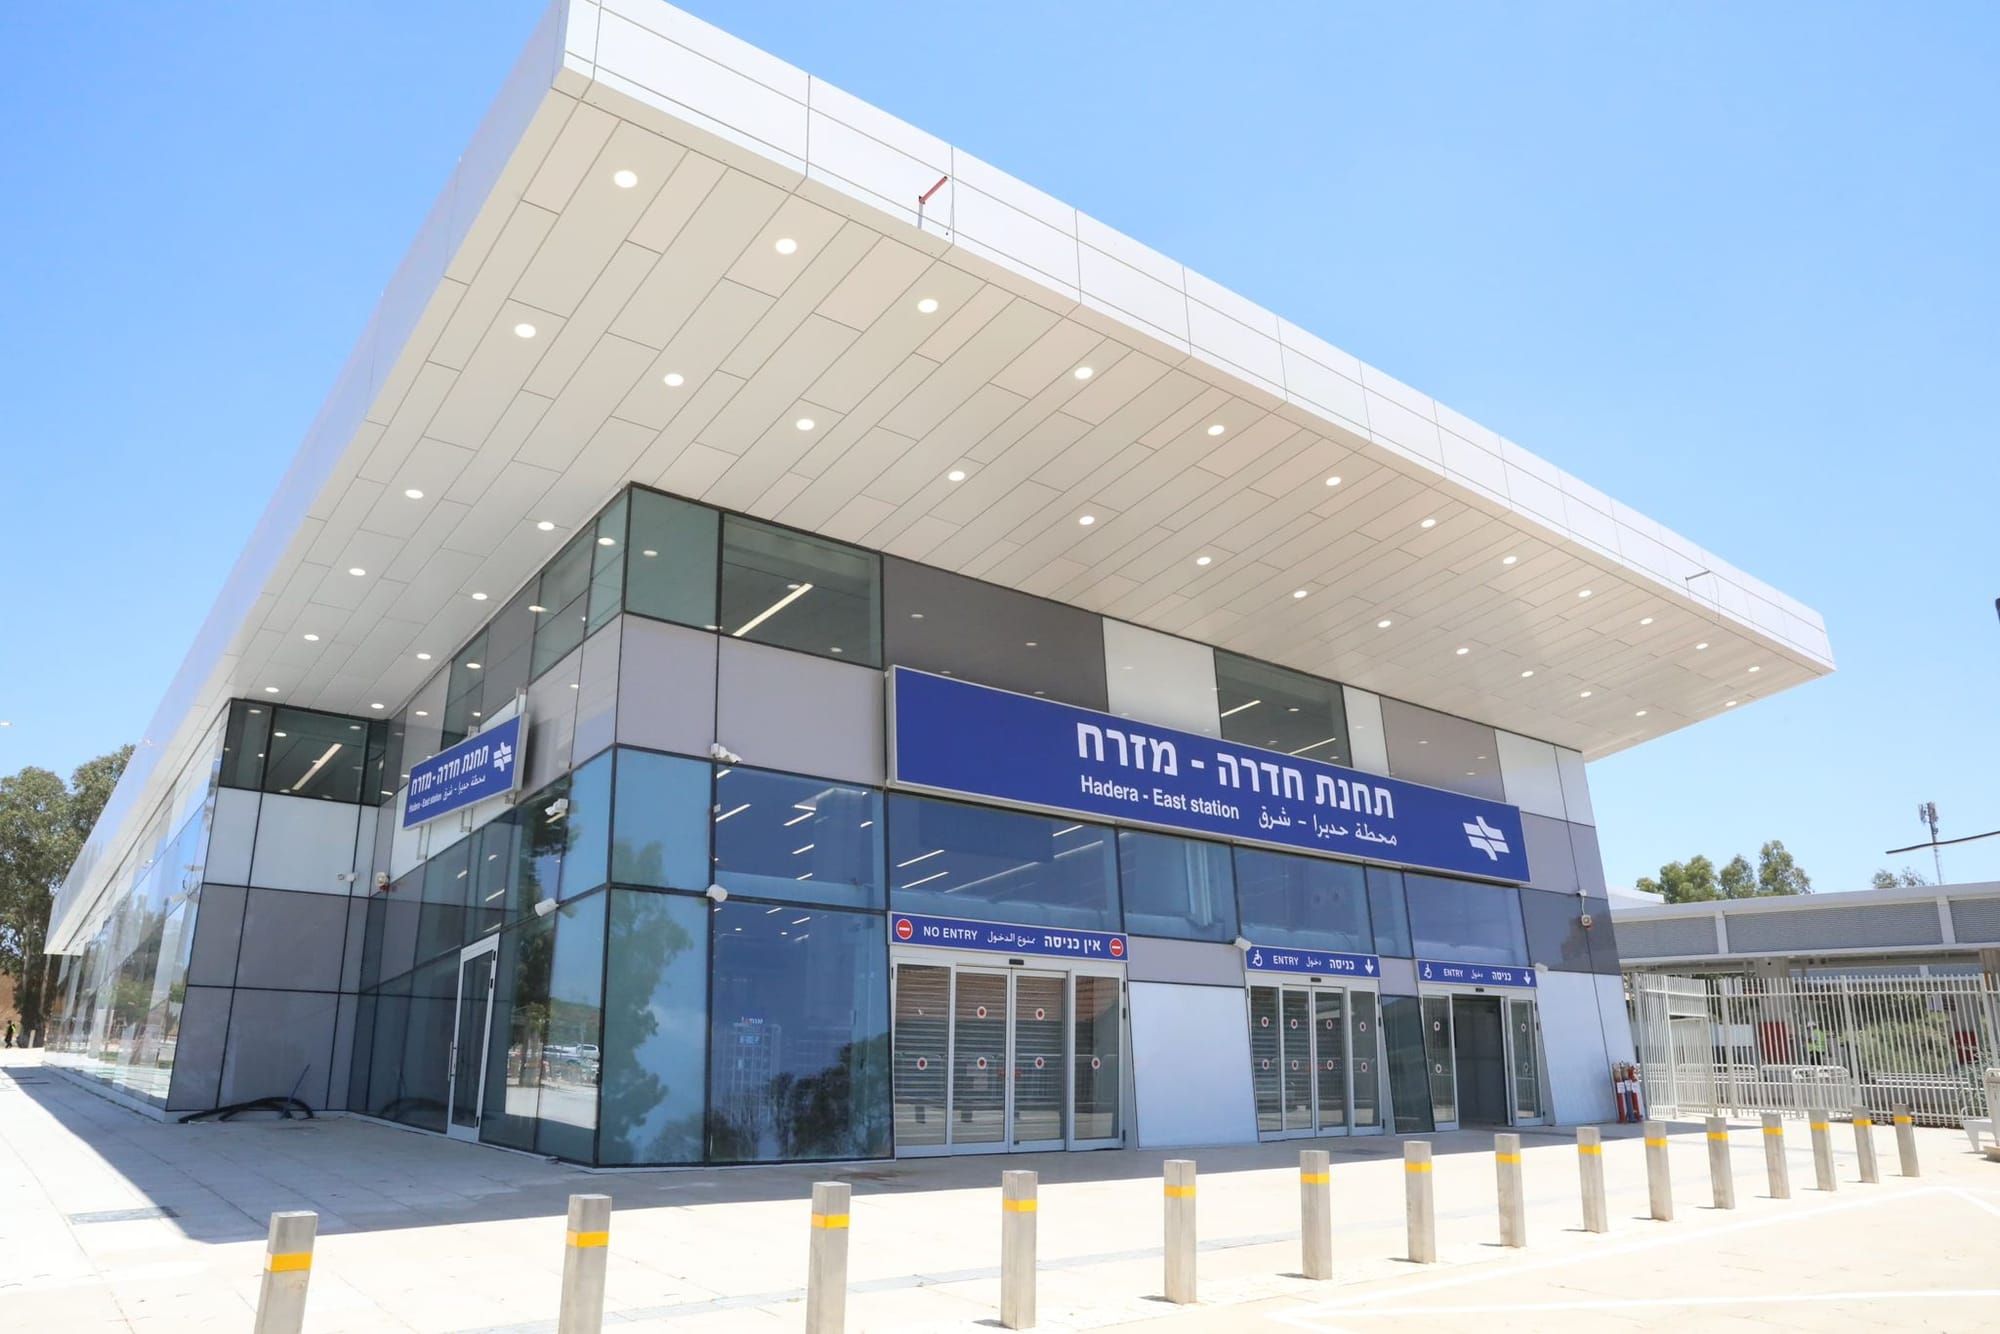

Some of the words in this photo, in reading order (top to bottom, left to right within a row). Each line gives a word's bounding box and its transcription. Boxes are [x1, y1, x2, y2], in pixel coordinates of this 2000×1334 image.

[1077, 722, 1178, 776] מזרח
[461, 745, 489, 775] תחנת
[1217, 752, 1305, 801] חדרה
[1081, 774, 1139, 802] Hadera
[1153, 788, 1187, 811] East
[1190, 797, 1240, 820] station
[1315, 774, 1394, 819] תחנת
[1258, 805, 1292, 830] شرق
[1313, 813, 1349, 839] حديرا
[1354, 821, 1398, 846] محطة
[924, 926, 940, 937] NO
[943, 927, 978, 940] ENTRY
[987, 931, 1015, 944] الدخول
[1044, 935, 1080, 950] כניסה
[1084, 939, 1101, 954] אין
[1273, 955, 1299, 966] ENTRY
[1329, 959, 1355, 970] כניסה
[1443, 968, 1464, 977] ENTRY
[1491, 971, 1512, 981] כניסה
